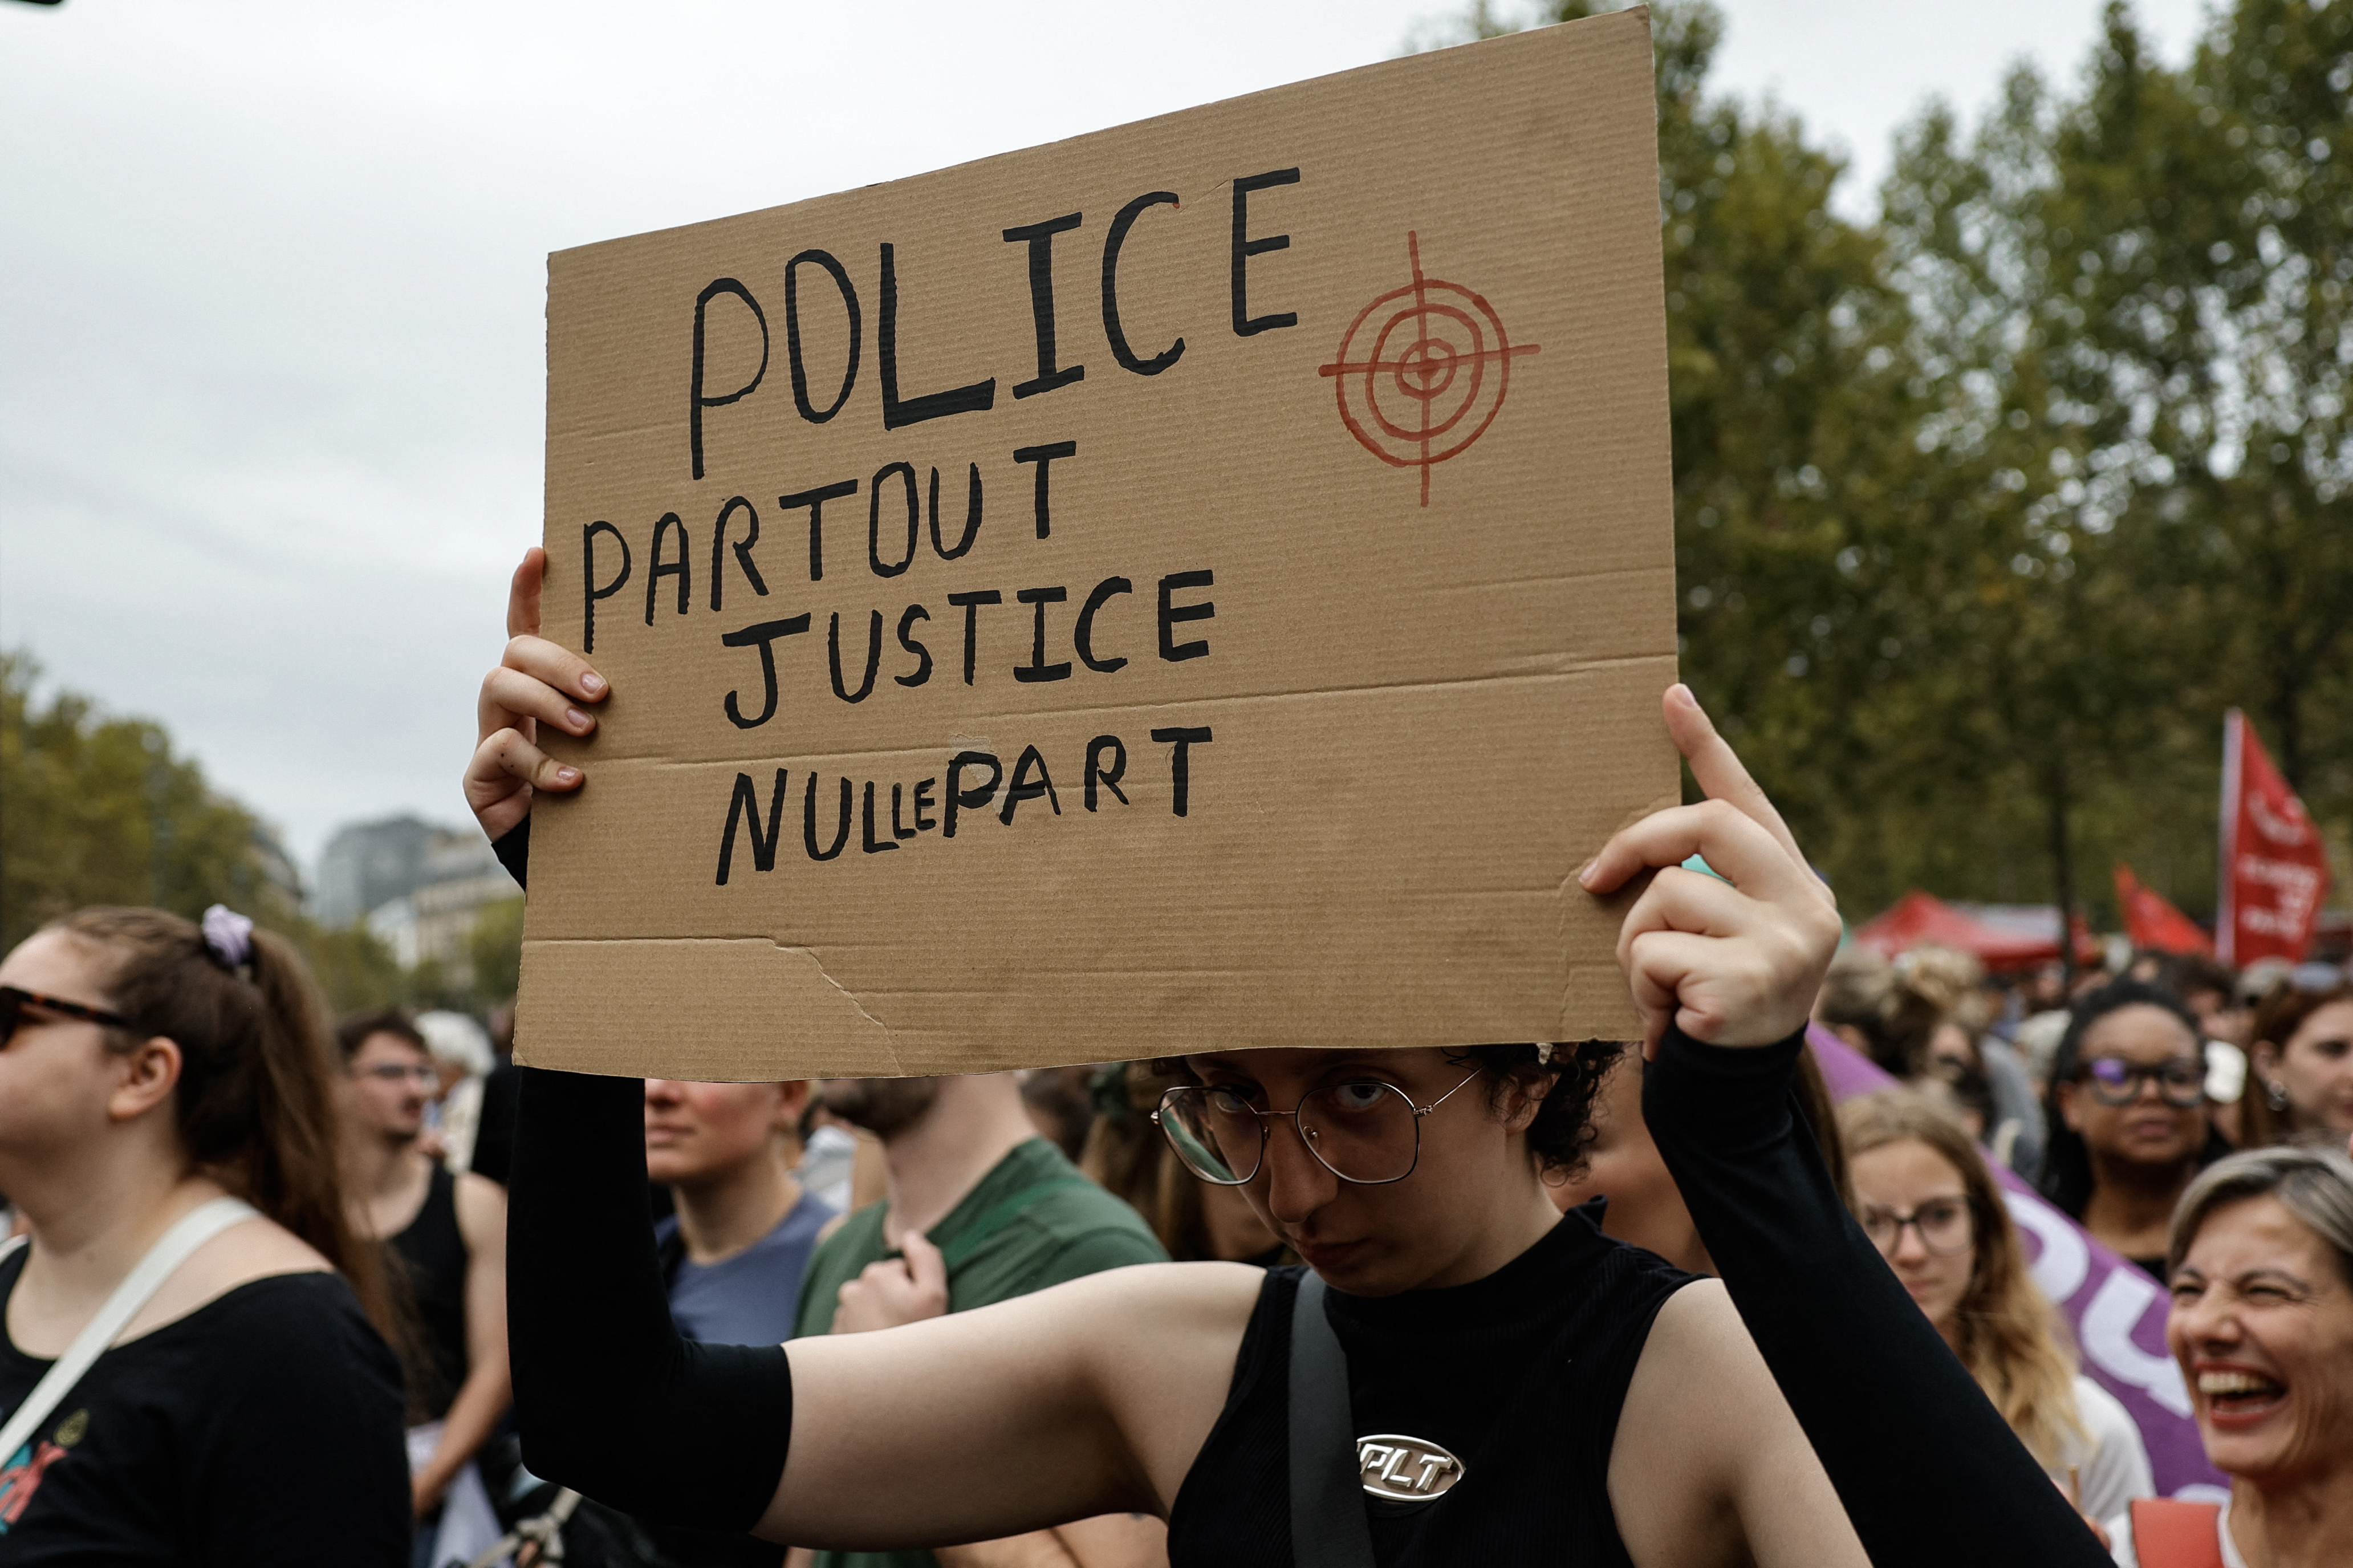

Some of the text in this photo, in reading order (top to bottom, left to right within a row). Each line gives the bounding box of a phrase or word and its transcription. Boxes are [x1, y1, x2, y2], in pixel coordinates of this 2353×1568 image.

[690, 166, 1301, 481] POLICE
[583, 440, 1077, 655] PARTOUT
[721, 569, 1216, 730] JUSTICE
[1360, 1443, 1454, 1492] PLT
